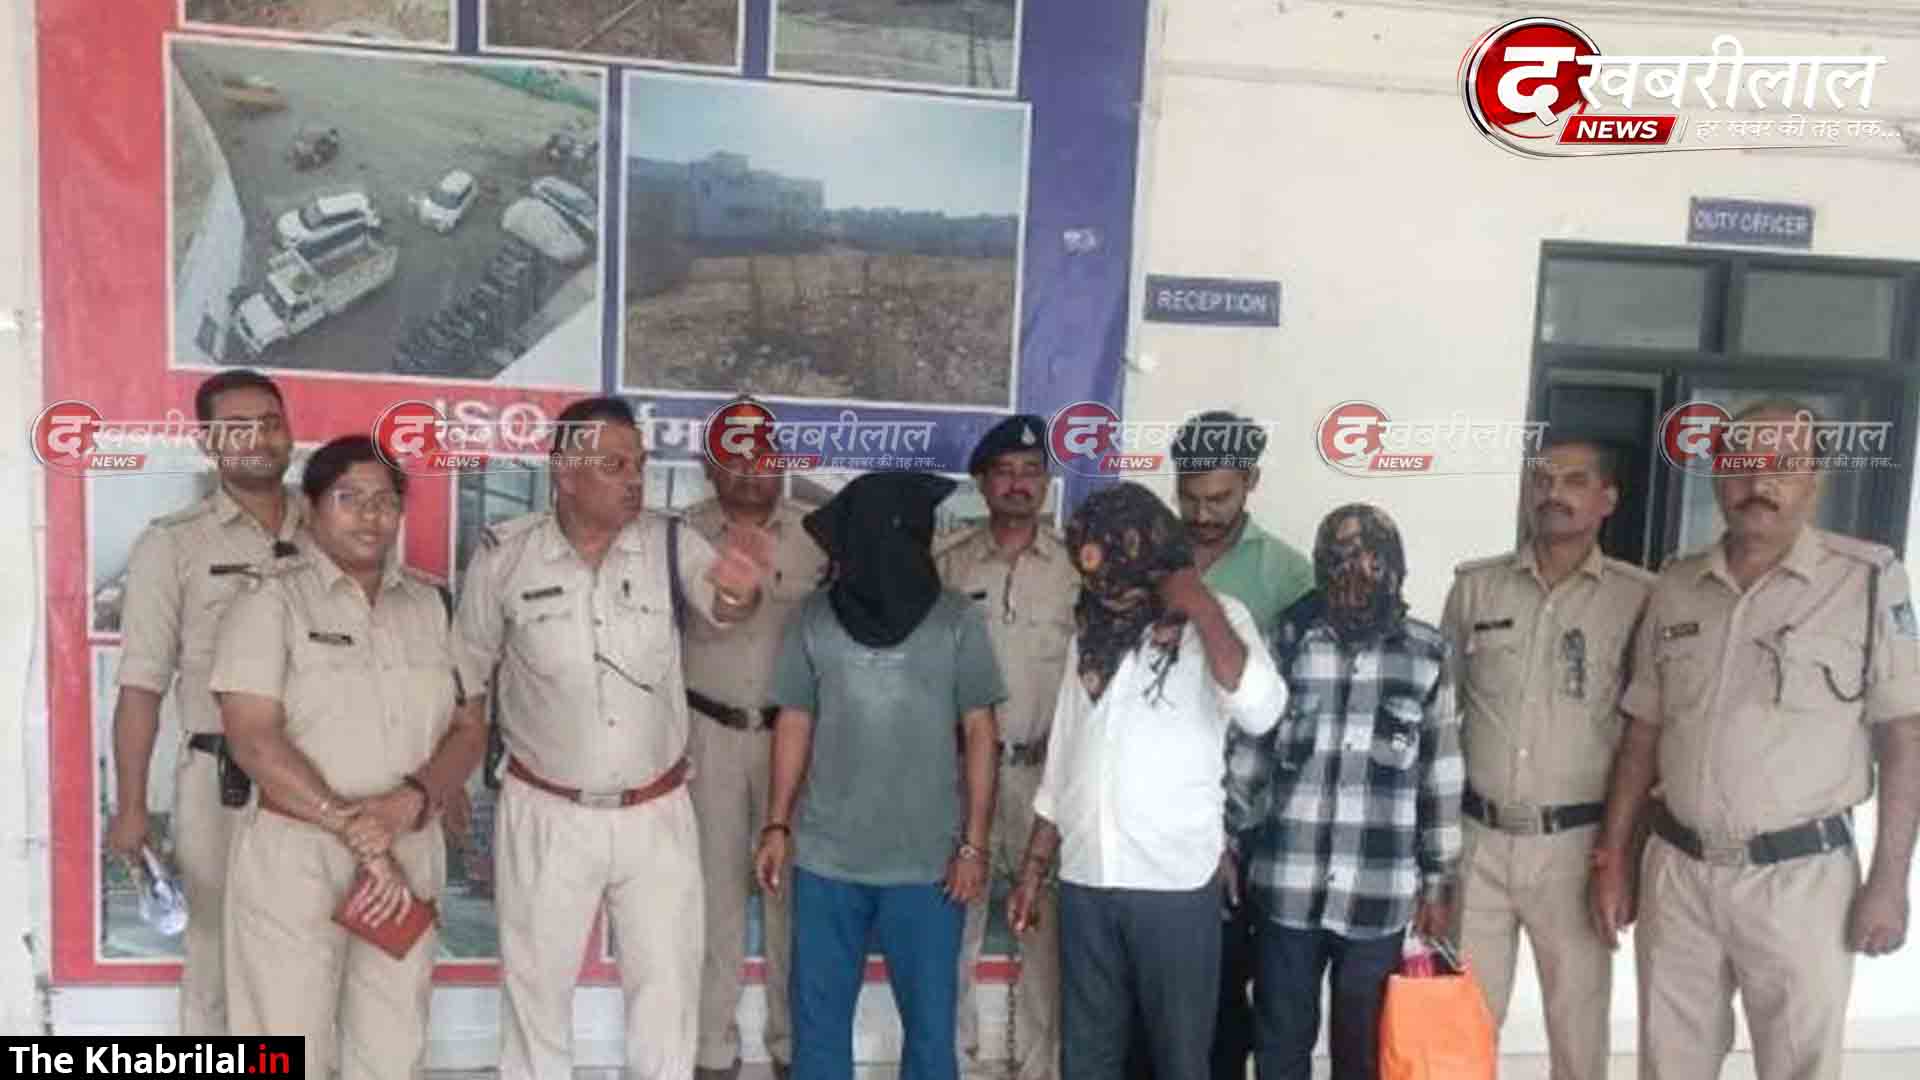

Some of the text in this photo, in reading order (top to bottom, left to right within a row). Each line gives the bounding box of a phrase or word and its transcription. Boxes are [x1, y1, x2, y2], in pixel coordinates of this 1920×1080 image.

[1695, 208, 1807, 234] DUTY OFFICER
[1157, 288, 1267, 313] RECEPTION
